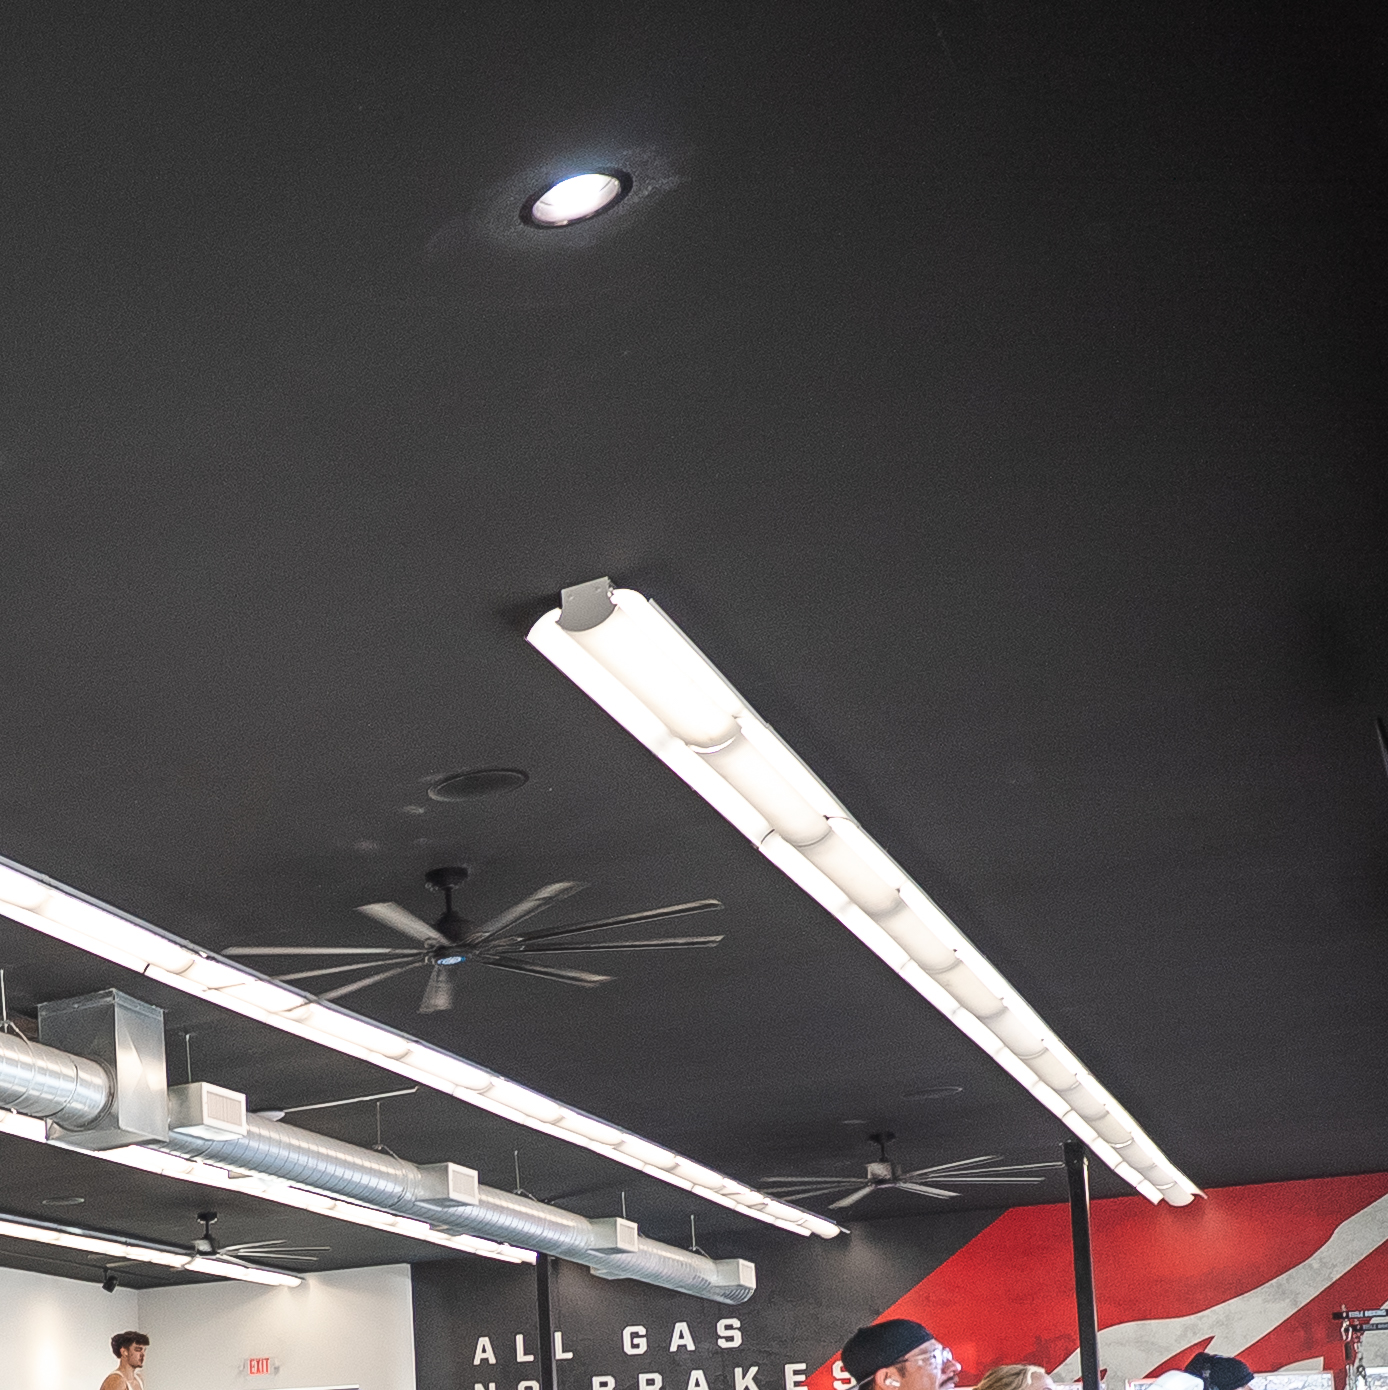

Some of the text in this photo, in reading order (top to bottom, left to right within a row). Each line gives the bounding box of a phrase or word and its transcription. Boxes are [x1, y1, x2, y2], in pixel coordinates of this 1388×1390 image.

[473, 1317, 743, 1366] ALL GAS
[249, 1358, 269, 1375] EXIT
